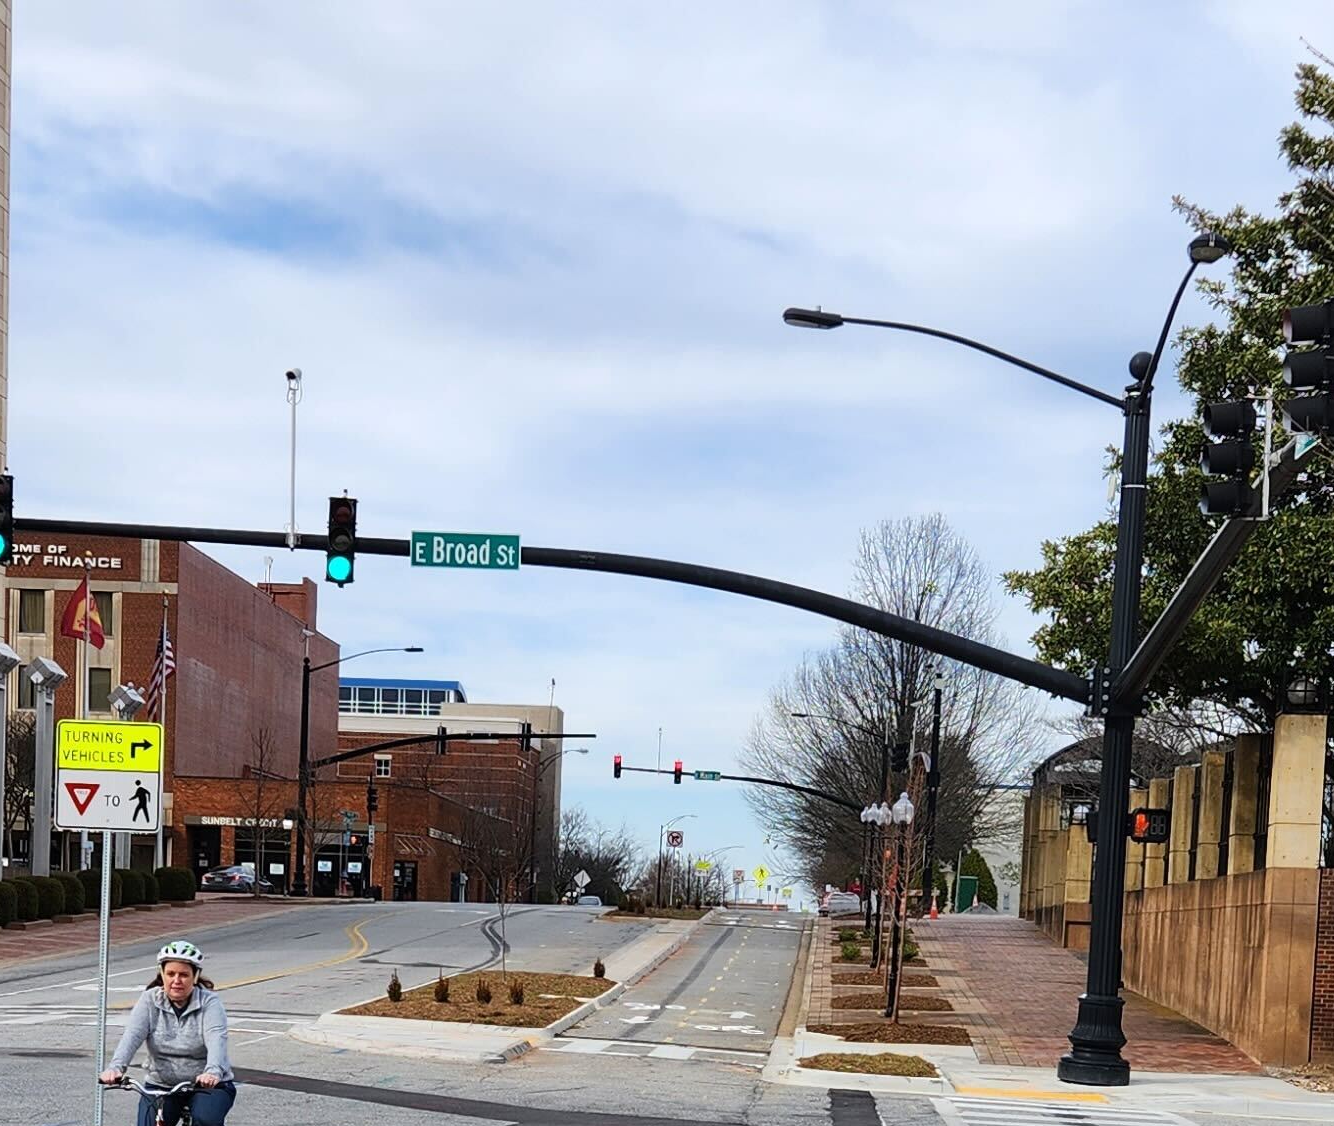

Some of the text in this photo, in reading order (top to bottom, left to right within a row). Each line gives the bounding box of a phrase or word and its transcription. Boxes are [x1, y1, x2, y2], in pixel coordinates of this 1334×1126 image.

[12, 543, 67, 554] OME OF
[415, 536, 515, 565] E Broad St
[43, 555, 122, 568] FINANCE
[65, 730, 123, 744] TURNING
[63, 750, 124, 763] VEHICLES
[104, 795, 121, 807] TO
[201, 816, 243, 826] SUNBELT
